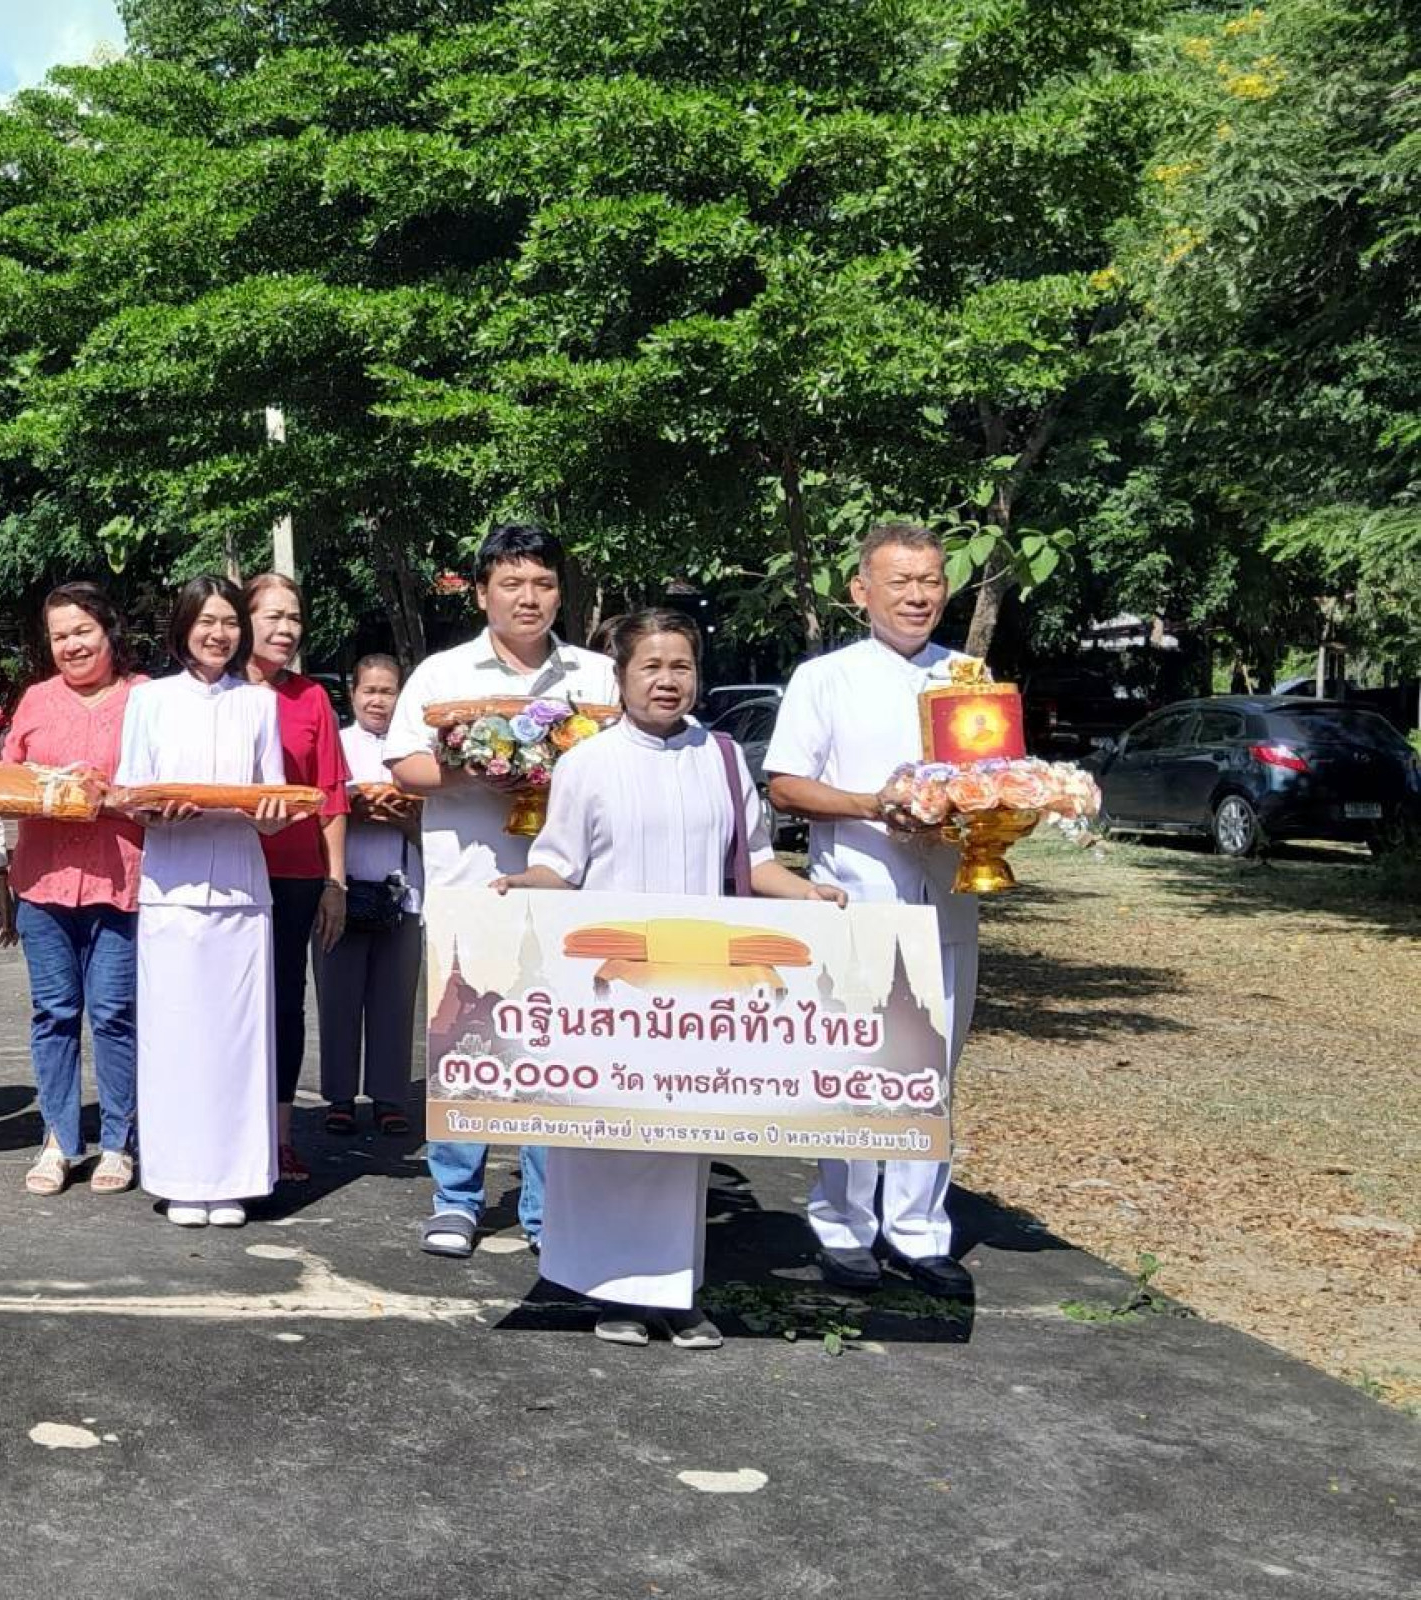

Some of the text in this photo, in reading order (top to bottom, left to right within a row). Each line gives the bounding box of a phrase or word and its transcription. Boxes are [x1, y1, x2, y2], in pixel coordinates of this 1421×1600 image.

[498, 988, 880, 1047] กฐินสามัคคีทั่วไทย
[444, 1059, 936, 1102] ๓๐,๐๐๐ วัด พุทธศักราช ๒๕๖๘
[448, 1111, 480, 1132] โดย
[489, 1115, 632, 1141] คณะศิษยานุศิษย์
[640, 1125, 726, 1144] บูชาธรรม
[766, 1124, 779, 1144] ปี
